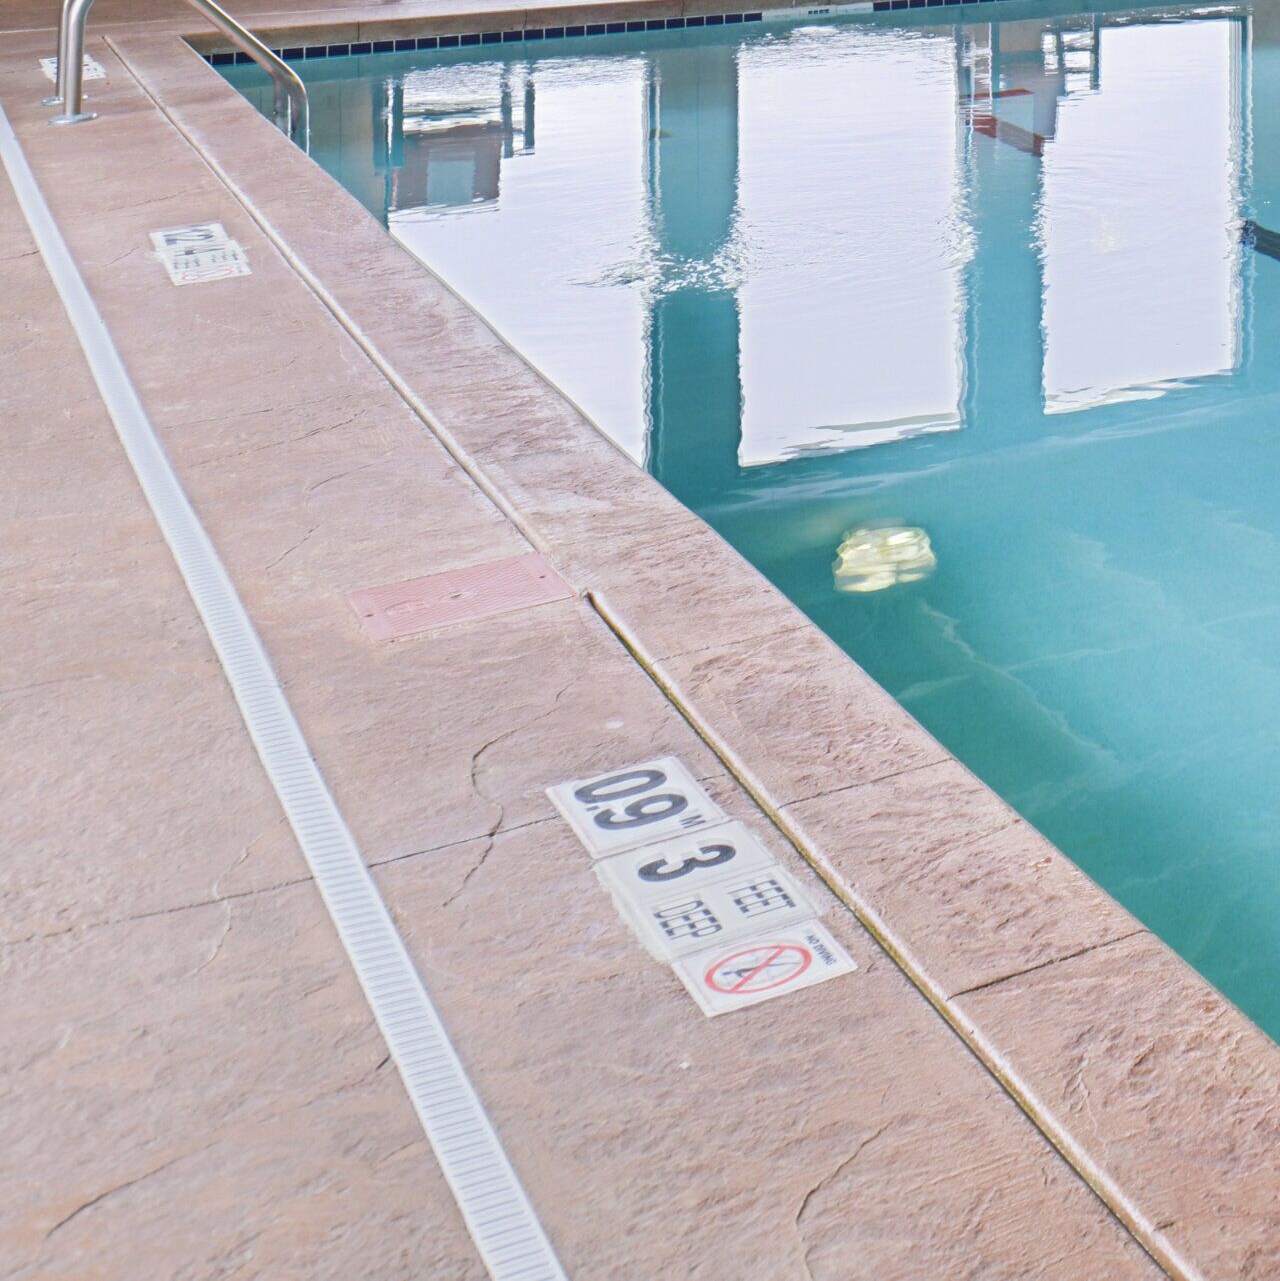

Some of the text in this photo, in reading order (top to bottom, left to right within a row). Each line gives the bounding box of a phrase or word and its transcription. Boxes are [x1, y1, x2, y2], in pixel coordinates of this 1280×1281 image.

[574, 769, 707, 830] 0.9 M
[638, 844, 736, 882] 3
[726, 879, 797, 918] FEET
[652, 900, 724, 940] DEEP
[804, 932, 837, 966] NO DIVING
